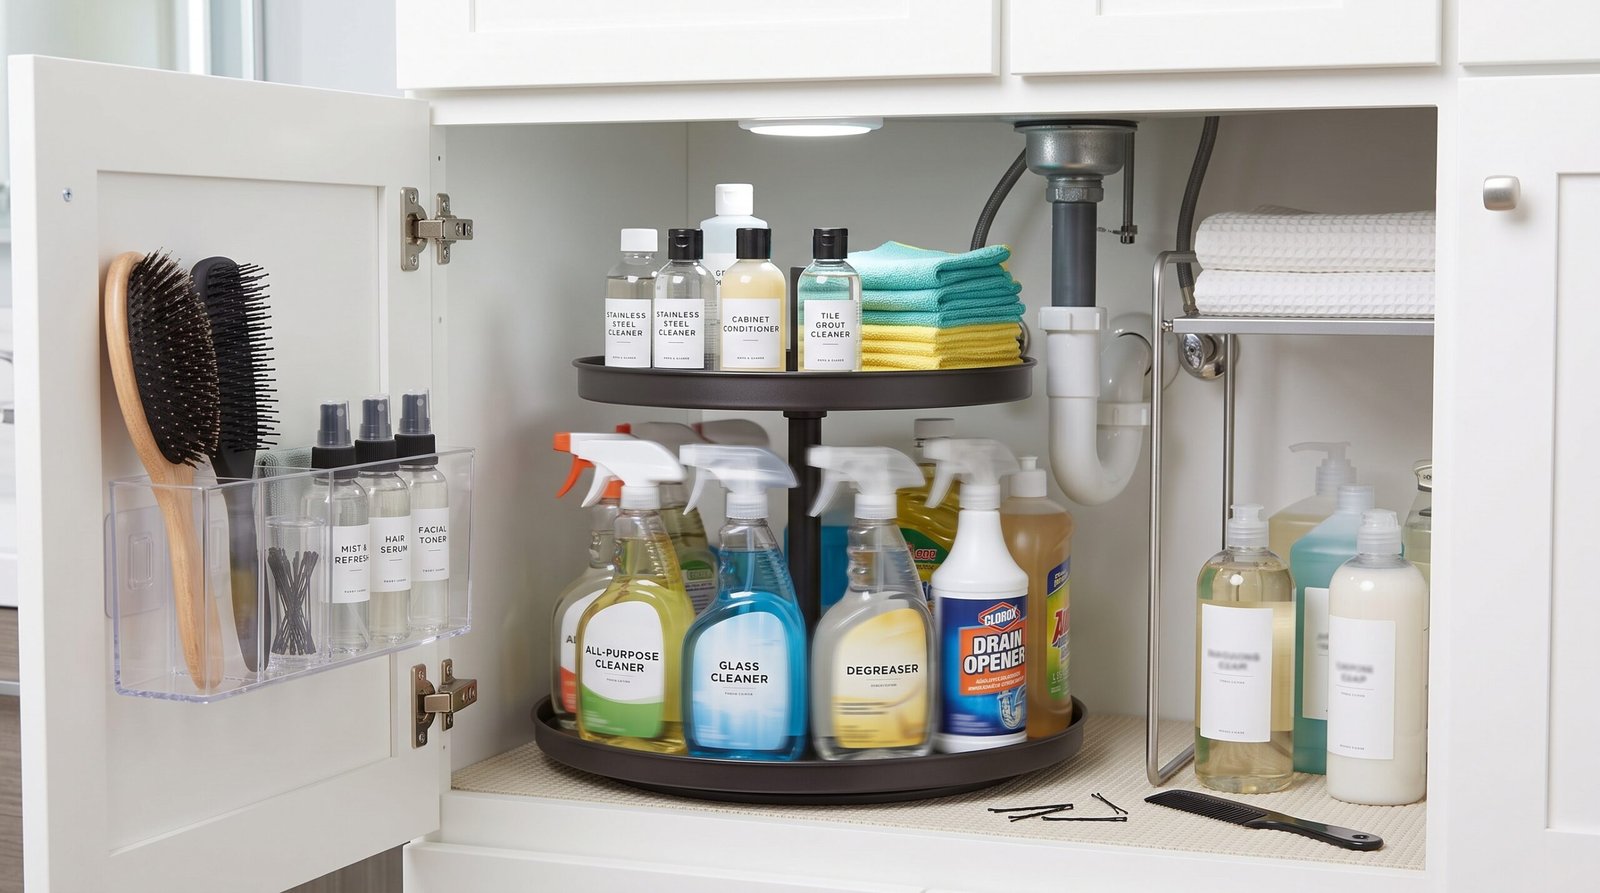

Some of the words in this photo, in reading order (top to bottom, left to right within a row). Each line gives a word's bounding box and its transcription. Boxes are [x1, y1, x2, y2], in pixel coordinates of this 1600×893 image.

[606, 311, 646, 319] STAINLESS
[656, 311, 700, 319] STAINLESS
[731, 315, 770, 323] CABINET
[821, 312, 840, 320] TILE
[612, 320, 636, 328] STEEL
[663, 320, 689, 328] STEEL
[815, 321, 846, 329] GROUT
[608, 328, 643, 337] CLEANER
[658, 329, 696, 337] CLEANER
[723, 325, 780, 333] CONDITIONER
[810, 330, 851, 338] CLEANER
[418, 525, 447, 534] FACIAL
[385, 534, 405, 543] HAIR
[419, 535, 447, 544] TONER
[341, 544, 361, 553] MIST
[380, 545, 408, 554] SERUM
[984, 605, 1018, 627] CLOROX
[973, 628, 1023, 656] DRAIN
[585, 645, 659, 661] ALL-PURPOSE
[963, 645, 1026, 675] OPENER
[595, 659, 645, 673] CLEANER
[719, 660, 760, 671] GLASS
[846, 663, 919, 675] DEGREASER
[710, 672, 769, 684] CLEANER
